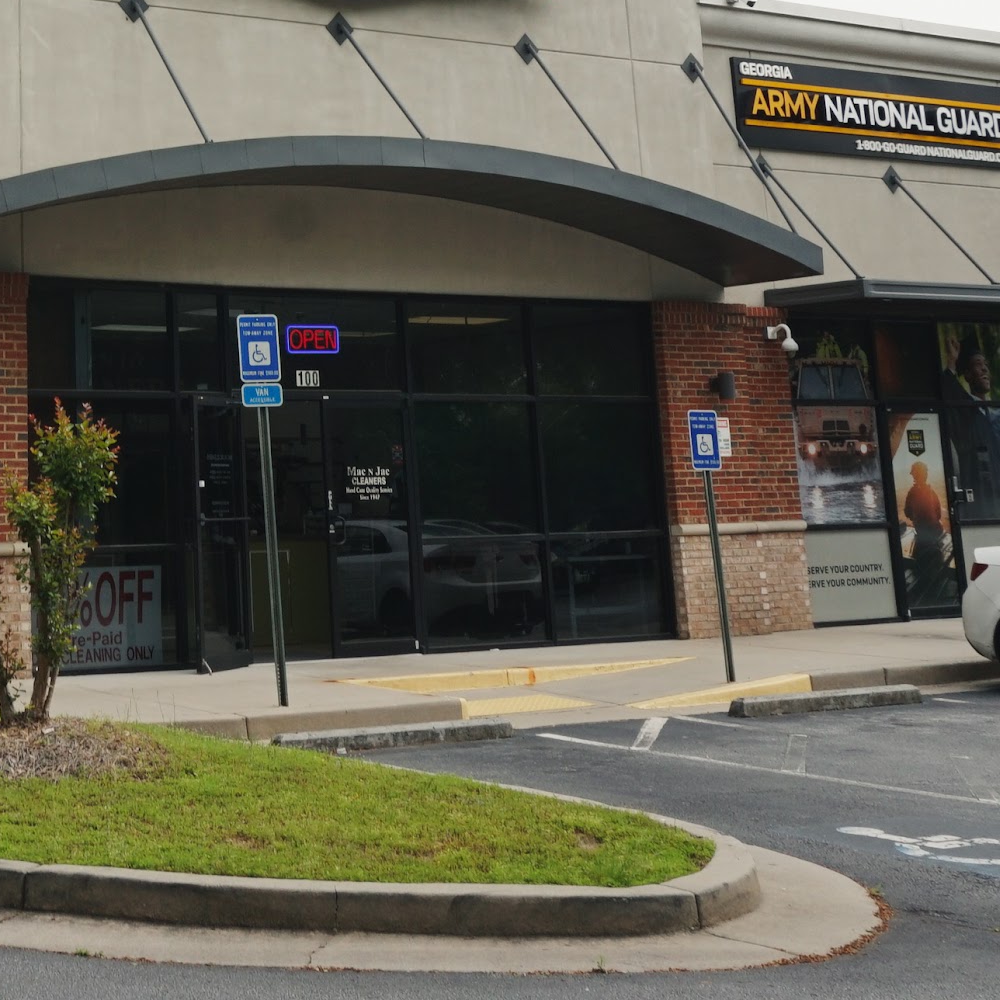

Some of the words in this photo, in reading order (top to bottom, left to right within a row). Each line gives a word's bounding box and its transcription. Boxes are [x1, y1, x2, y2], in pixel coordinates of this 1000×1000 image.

[739, 61, 793, 80] GEORGIA
[752, 88, 819, 120] ARMY
[824, 94, 935, 132] NATIONAL
[936, 107, 1000, 139] GUARD
[855, 139, 926, 156] 1-800-GO-GUARD
[289, 329, 337, 350] OPEN
[298, 371, 318, 385] 100
[255, 388, 269, 396] VAN
[347, 466, 366, 476] Mac
[375, 466, 390, 476] Jac
[351, 476, 387, 486] CLEANERS
[829, 565, 849, 574] YOUR
[850, 563, 885, 573] COUNTRY.
[808, 579, 826, 589] ERVE
[826, 578, 846, 588] YOUR
[846, 576, 891, 587] COMMUNITY.
[95, 570, 154, 627] OFF
[70, 631, 123, 648] re-Paid
[127, 645, 155, 661] ONLY
